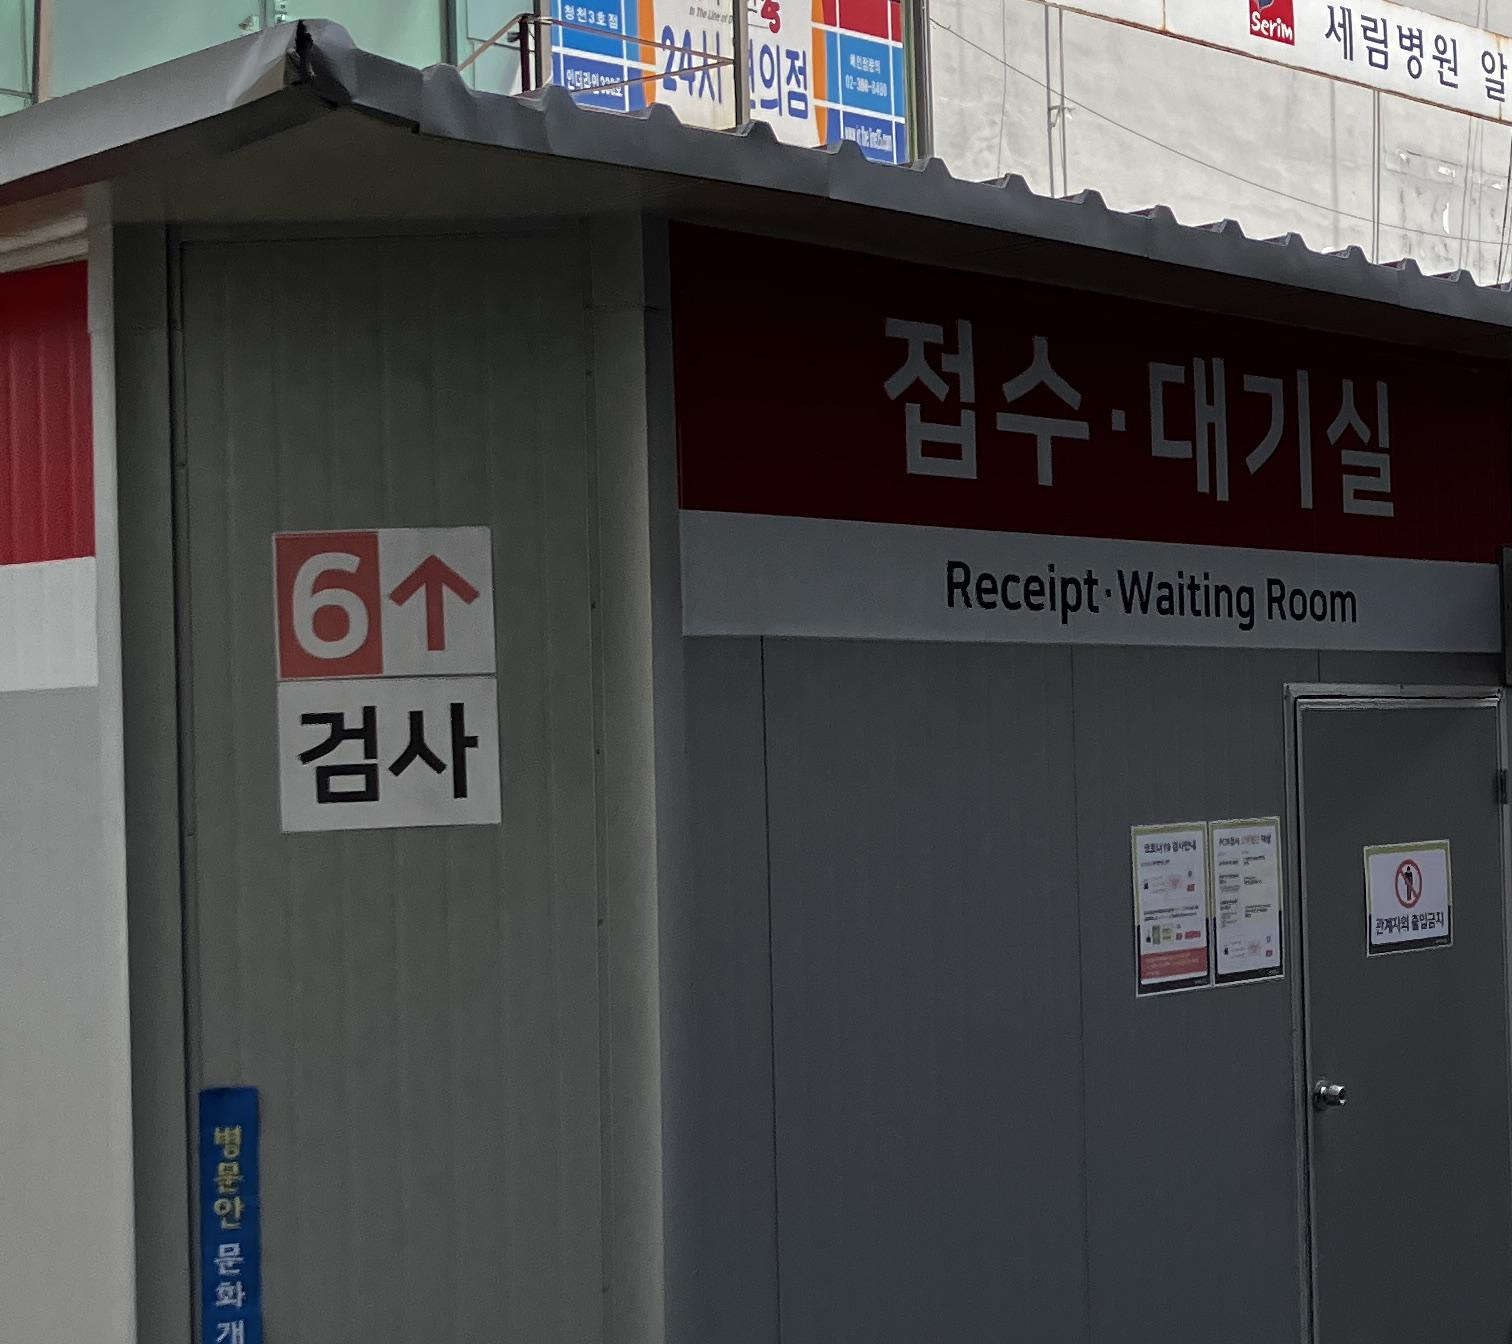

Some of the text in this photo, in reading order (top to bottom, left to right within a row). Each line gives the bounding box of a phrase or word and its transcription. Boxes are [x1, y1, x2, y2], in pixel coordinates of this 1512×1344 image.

[661, 25, 722, 104] 24시
[1251, 10, 1293, 41] Serim
[1325, 6, 1459, 89] 세림병원
[292, 551, 370, 660] 6
[1266, 577, 1359, 624] Room
[298, 702, 479, 805] 검사
[1412, 911, 1444, 931] 출입금지
[213, 1125, 243, 1231] 병문안
[214, 1242, 245, 1310] 문화
